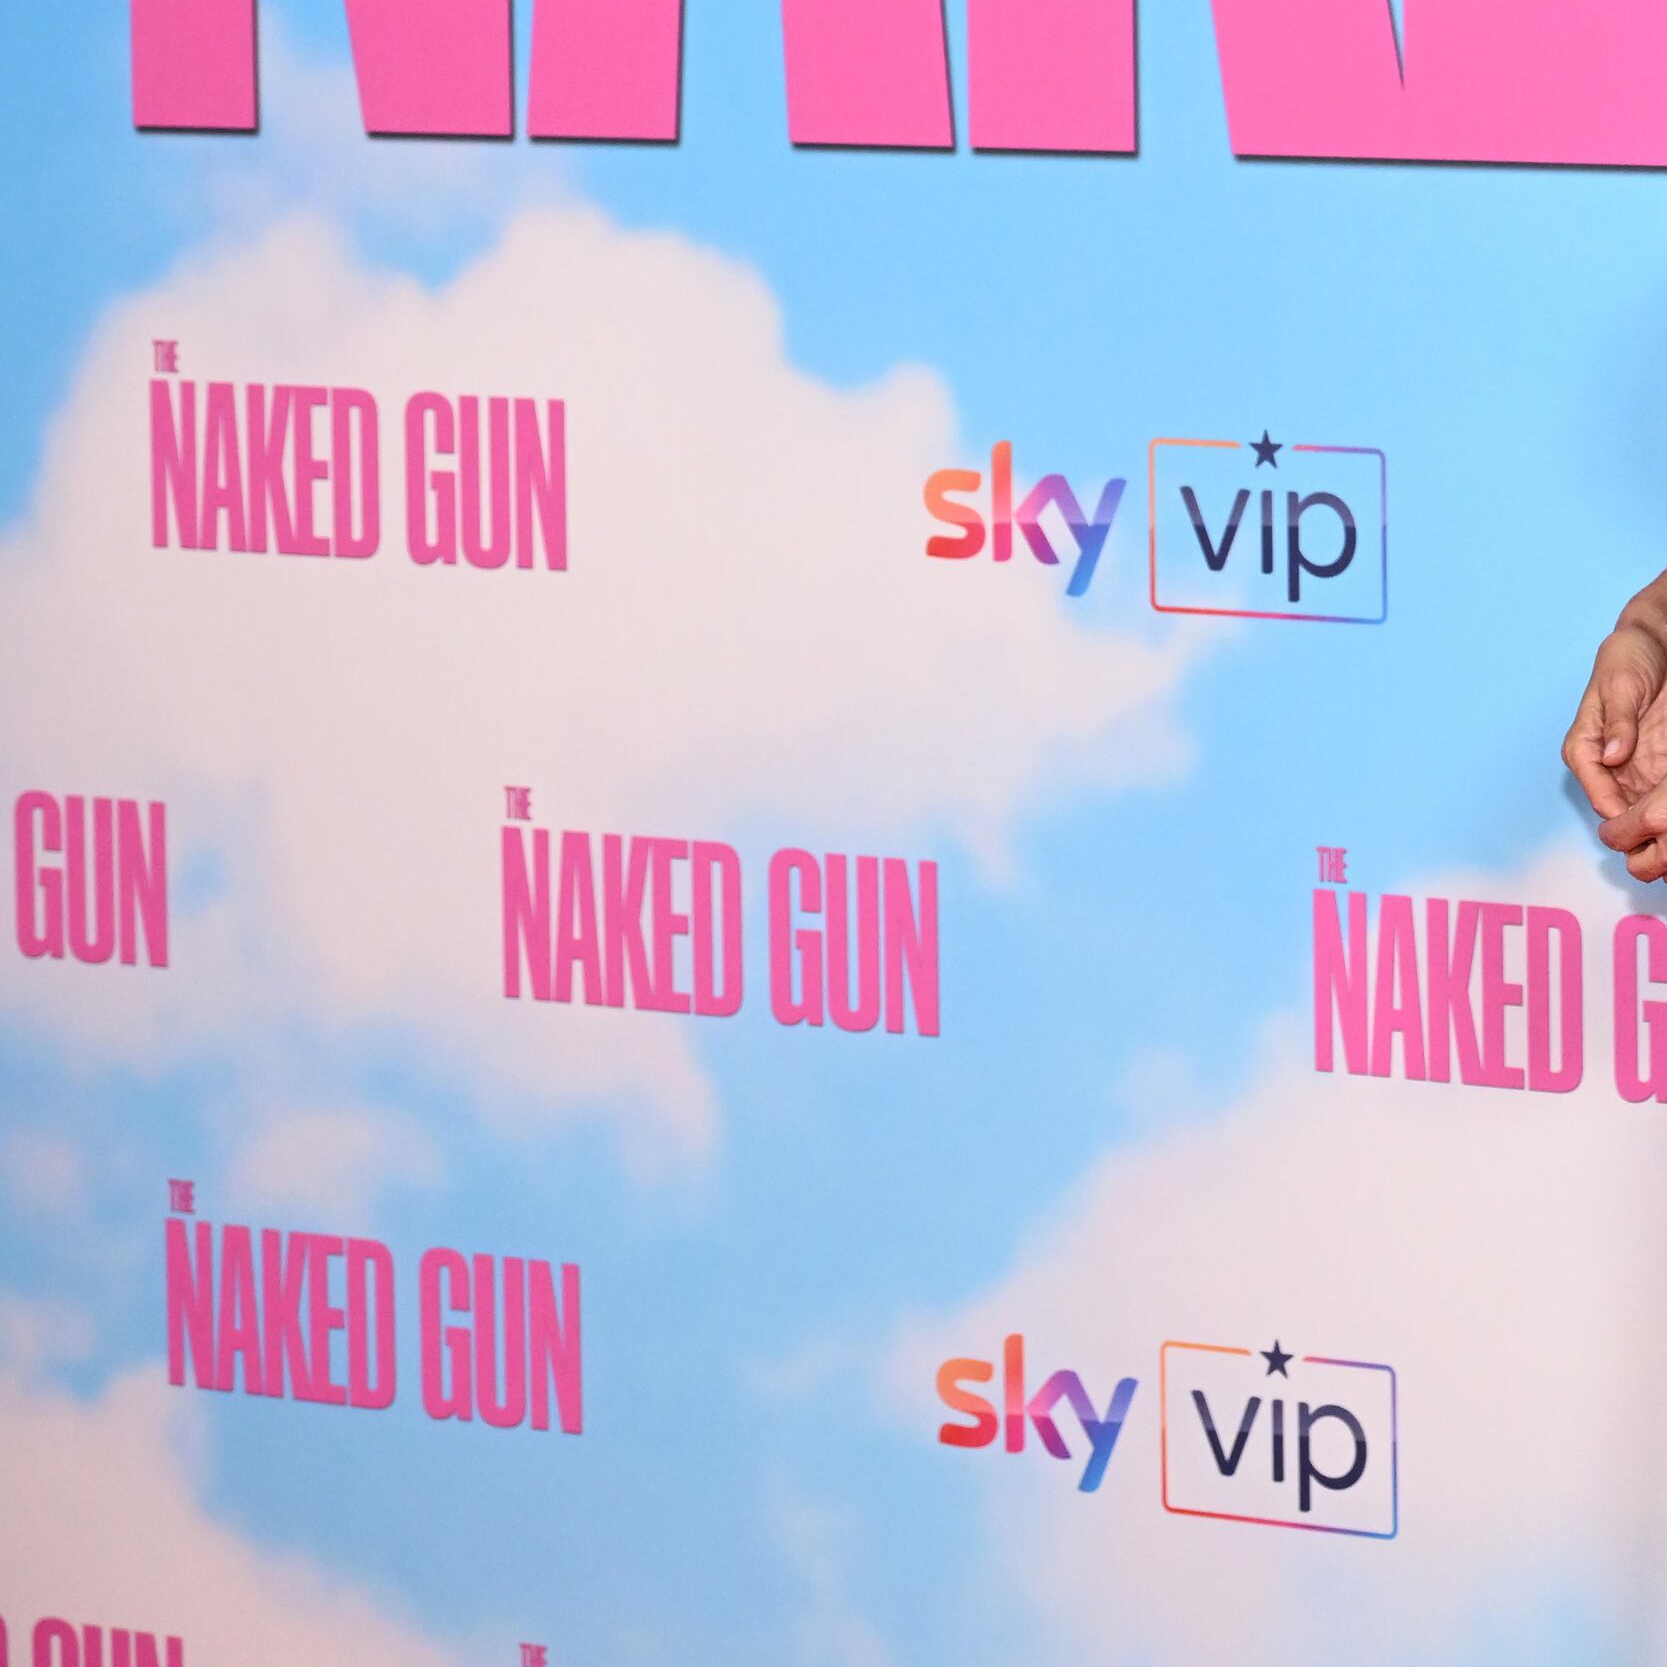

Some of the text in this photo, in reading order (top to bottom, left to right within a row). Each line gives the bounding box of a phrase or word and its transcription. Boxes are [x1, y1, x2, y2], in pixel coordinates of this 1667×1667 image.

[151, 337, 180, 375] THE
[148, 376, 570, 573] NAKED GUN
[922, 429, 1358, 603] sky vip
[11, 788, 170, 970] GUN
[503, 782, 534, 823] THE
[1316, 845, 1348, 884] THE
[499, 823, 942, 1039] NAKED GUN
[1312, 888, 1585, 1094] NAKED
[168, 1177, 195, 1215] THE
[165, 1217, 584, 1435] NAKED GUN
[935, 1333, 1368, 1512] sky vip
